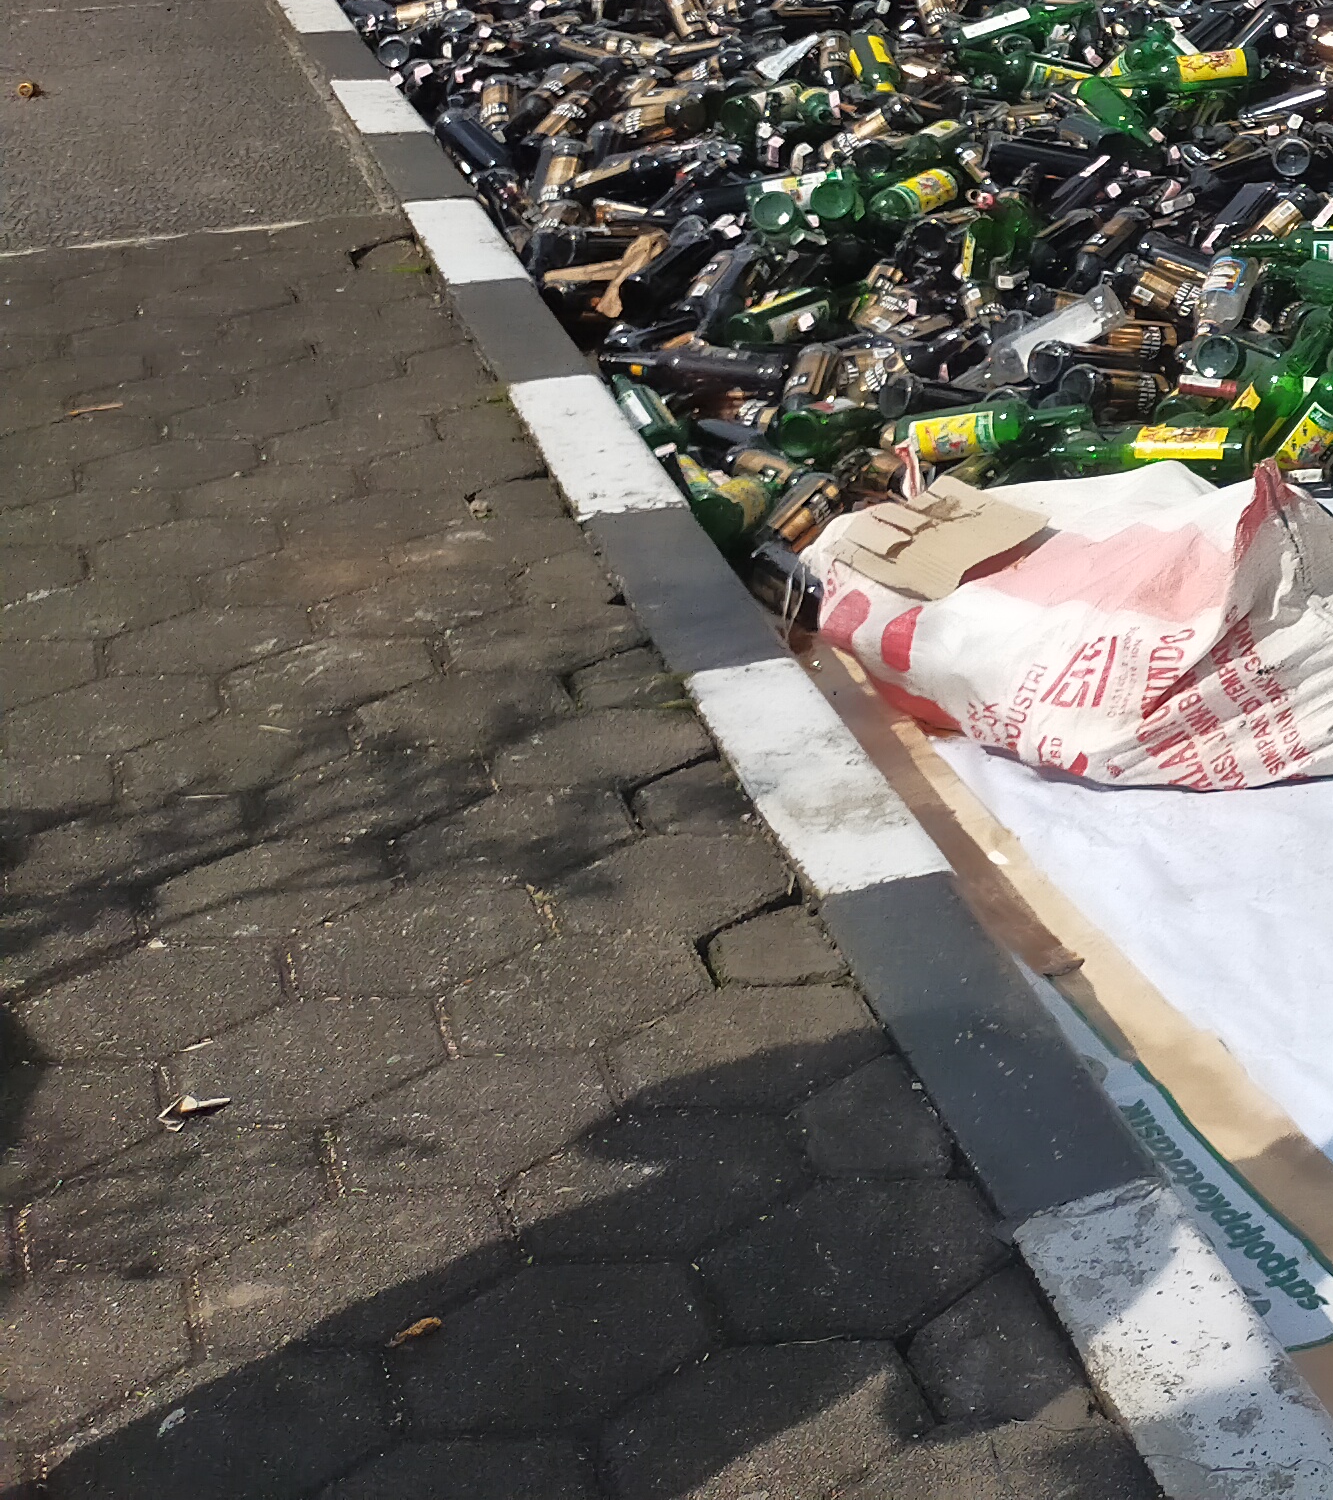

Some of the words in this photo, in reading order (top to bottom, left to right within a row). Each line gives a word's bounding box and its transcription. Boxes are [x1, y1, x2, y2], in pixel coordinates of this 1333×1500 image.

[1237, 695, 1263, 716] DI
[1250, 713, 1286, 776] SIMPAN
[1276, 706, 1316, 770] JANGAN
